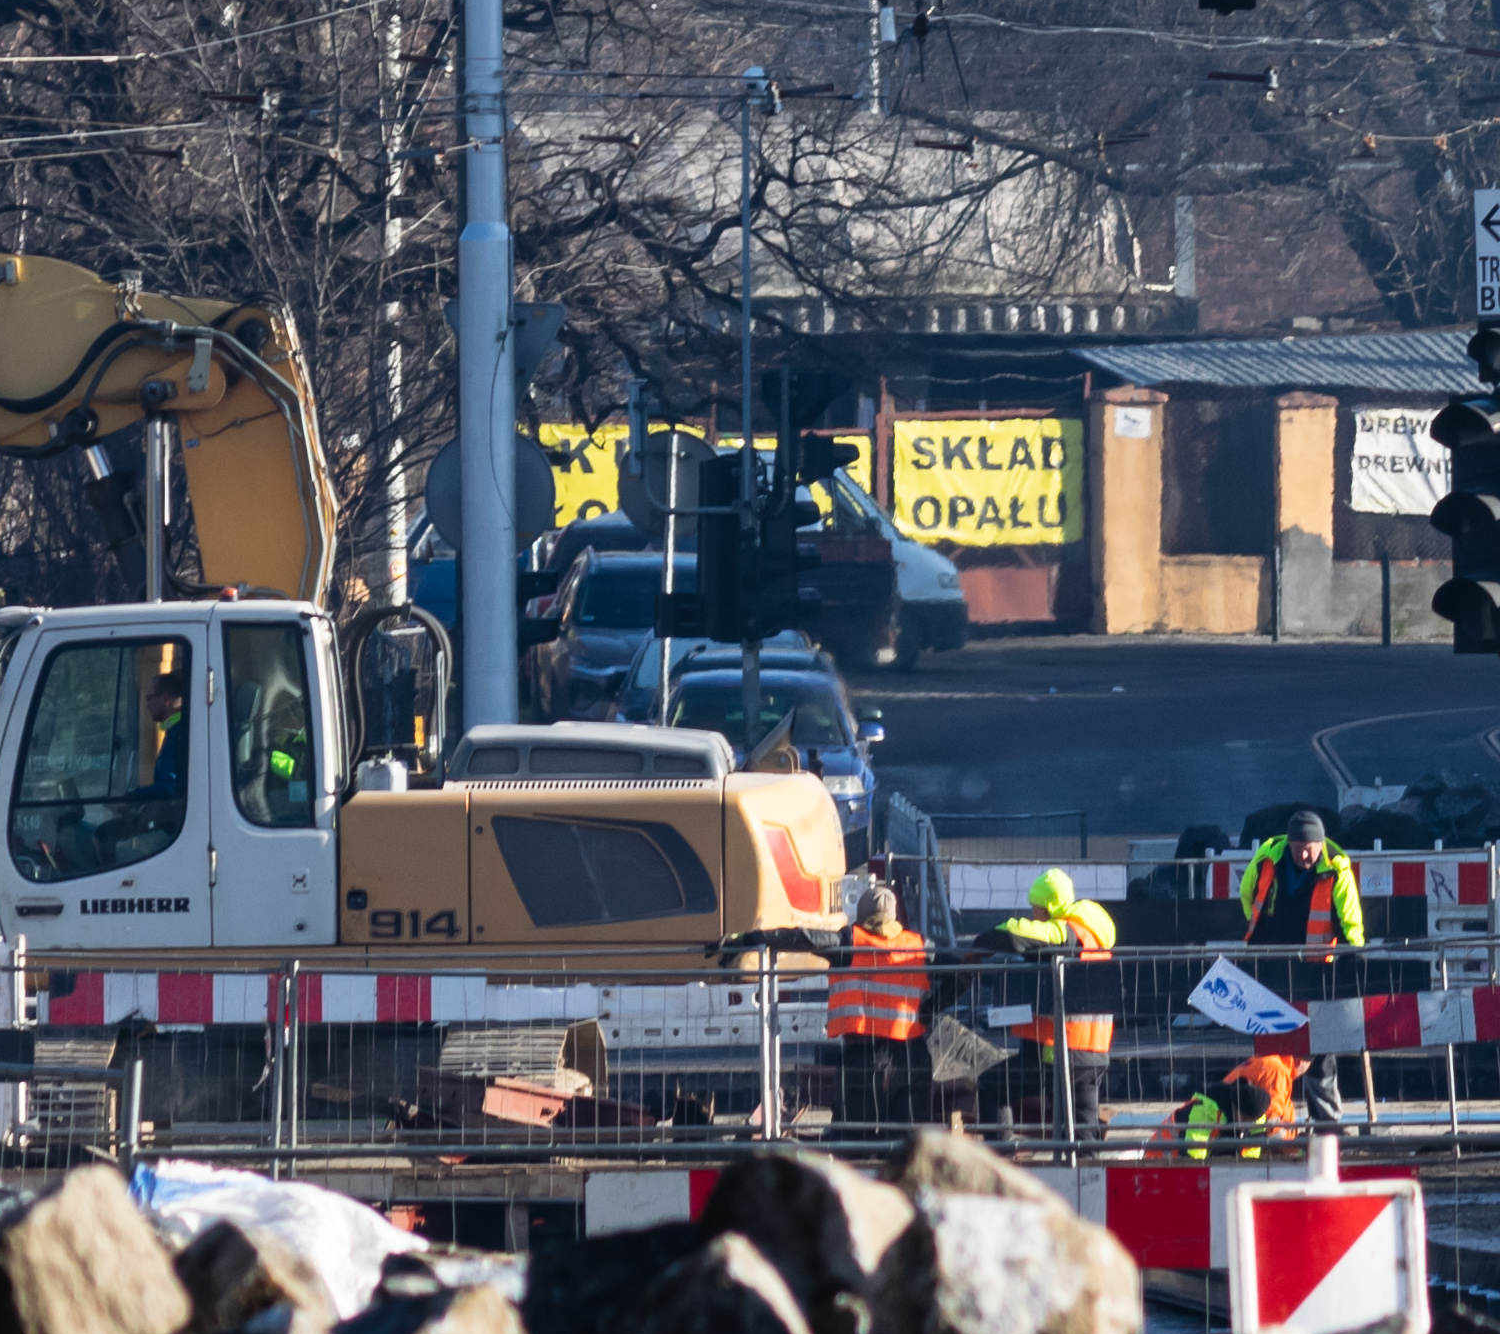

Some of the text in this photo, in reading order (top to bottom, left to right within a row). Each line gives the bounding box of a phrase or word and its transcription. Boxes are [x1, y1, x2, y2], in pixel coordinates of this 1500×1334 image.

[911, 435, 1068, 471] SKŁAD
[911, 495, 1068, 530] OPAŁU
[80, 897, 190, 915] LIEBHERR
[369, 908, 462, 940] 914
